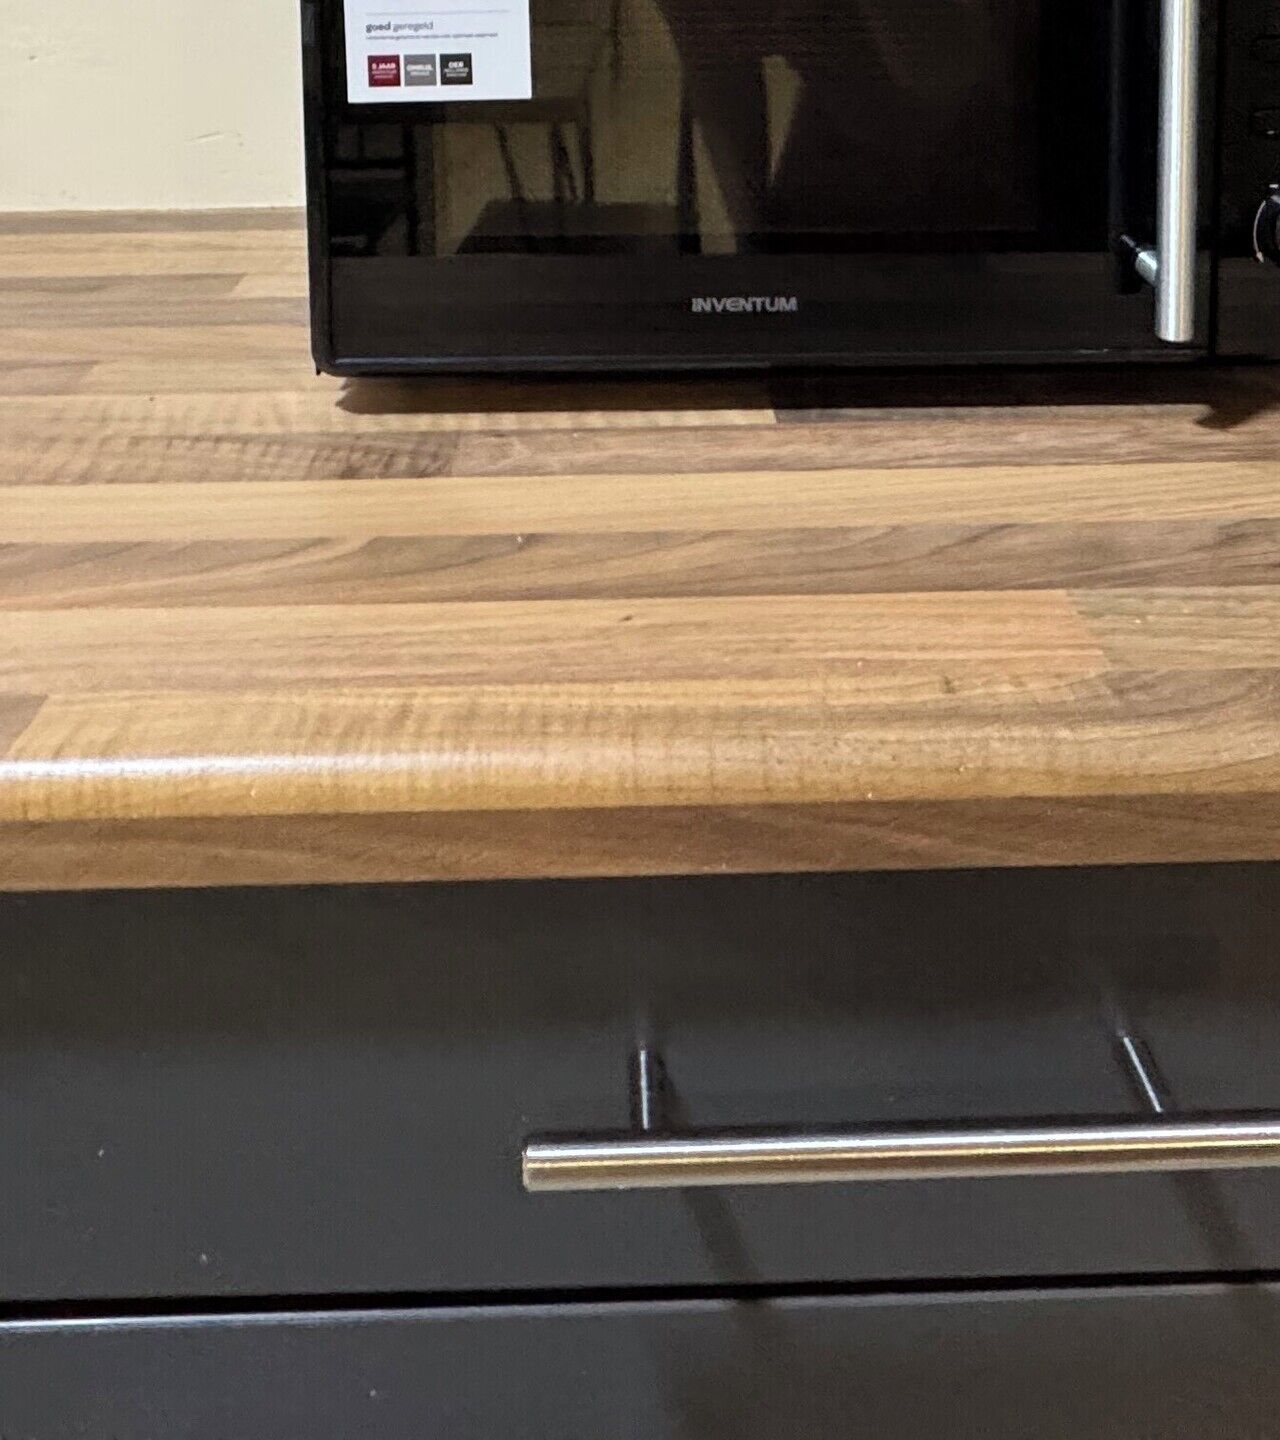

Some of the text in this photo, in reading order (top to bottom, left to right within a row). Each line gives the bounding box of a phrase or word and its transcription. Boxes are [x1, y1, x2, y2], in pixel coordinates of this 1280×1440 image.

[365, 21, 434, 33] goed geregeld
[691, 296, 799, 313] INVENTUM
